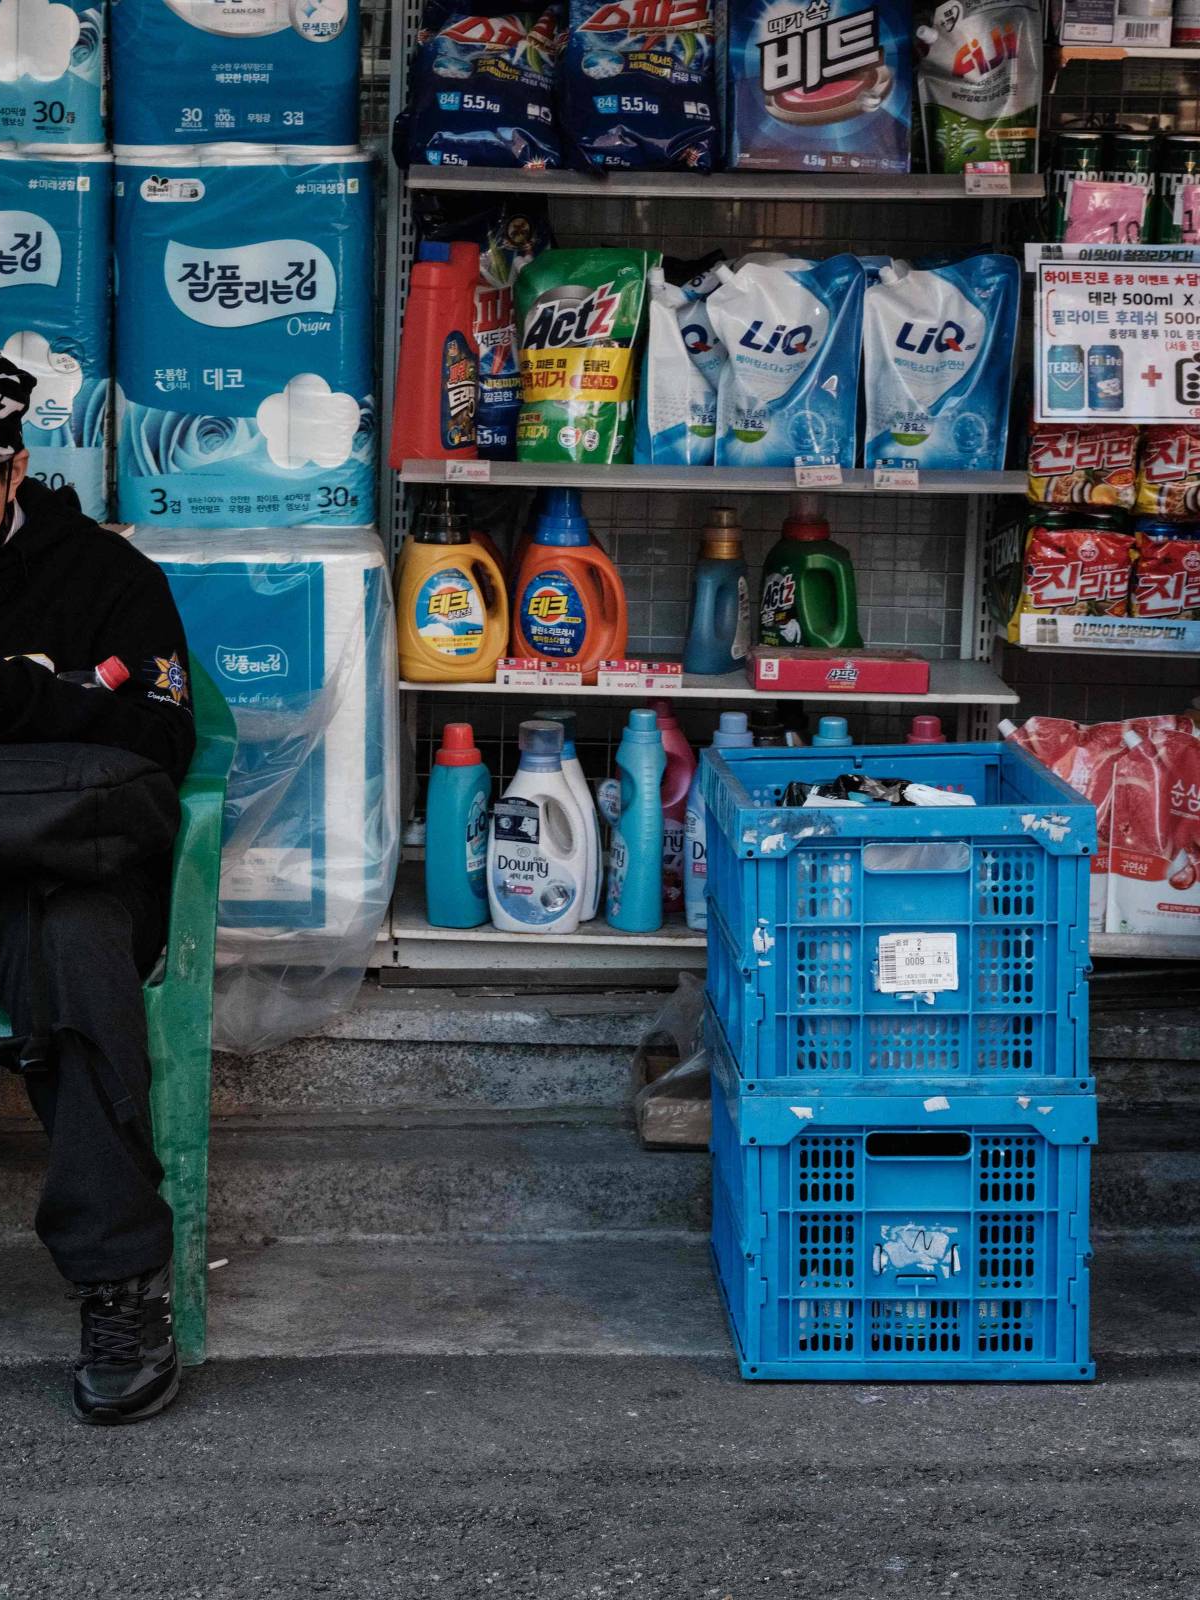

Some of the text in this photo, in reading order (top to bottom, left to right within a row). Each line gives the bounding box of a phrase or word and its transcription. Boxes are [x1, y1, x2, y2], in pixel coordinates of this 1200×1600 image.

[768, 12, 802, 34] 때가
[762, 9, 881, 92] 비트
[216, 74, 269, 83] 깨끗한 마무리
[182, 108, 202, 122] 30
[283, 112, 304, 125] 3겹
[177, 260, 316, 309] 잘풀리는집
[1044, 271, 1110, 285] 하이트진로
[1114, 274, 1134, 285] 증정
[1138, 275, 1168, 285] 이벤트
[1089, 292, 1116, 305] 테라
[1123, 293, 1172, 305] 500ml
[1052, 310, 1109, 325] 필라이트
[1116, 310, 1158, 325] 후레쉬
[288, 317, 330, 335] Origin
[739, 321, 813, 355] LiQ
[896, 321, 965, 354] LiQ
[1109, 329, 1136, 339] 종량제
[1142, 330, 1159, 339] 봉투
[1164, 330, 1182, 338] 10L
[154, 368, 244, 390] 도톰함 데코
[821, 455, 836, 464] 1+1
[1030, 431, 1134, 476] 진라면
[902, 460, 916, 468] 1+1
[428, 590, 468, 615] 테크
[528, 595, 568, 617] 테크
[222, 654, 281, 674] 잘풀리는집
[524, 660, 538, 669] 1+1
[566, 663, 580, 671] 1+1
[625, 662, 639, 670] 1+1
[667, 665, 681, 673] 1+1
[498, 856, 549, 878] Downy
[1121, 860, 1148, 875] 구연산
[905, 957, 924, 965] 0009
